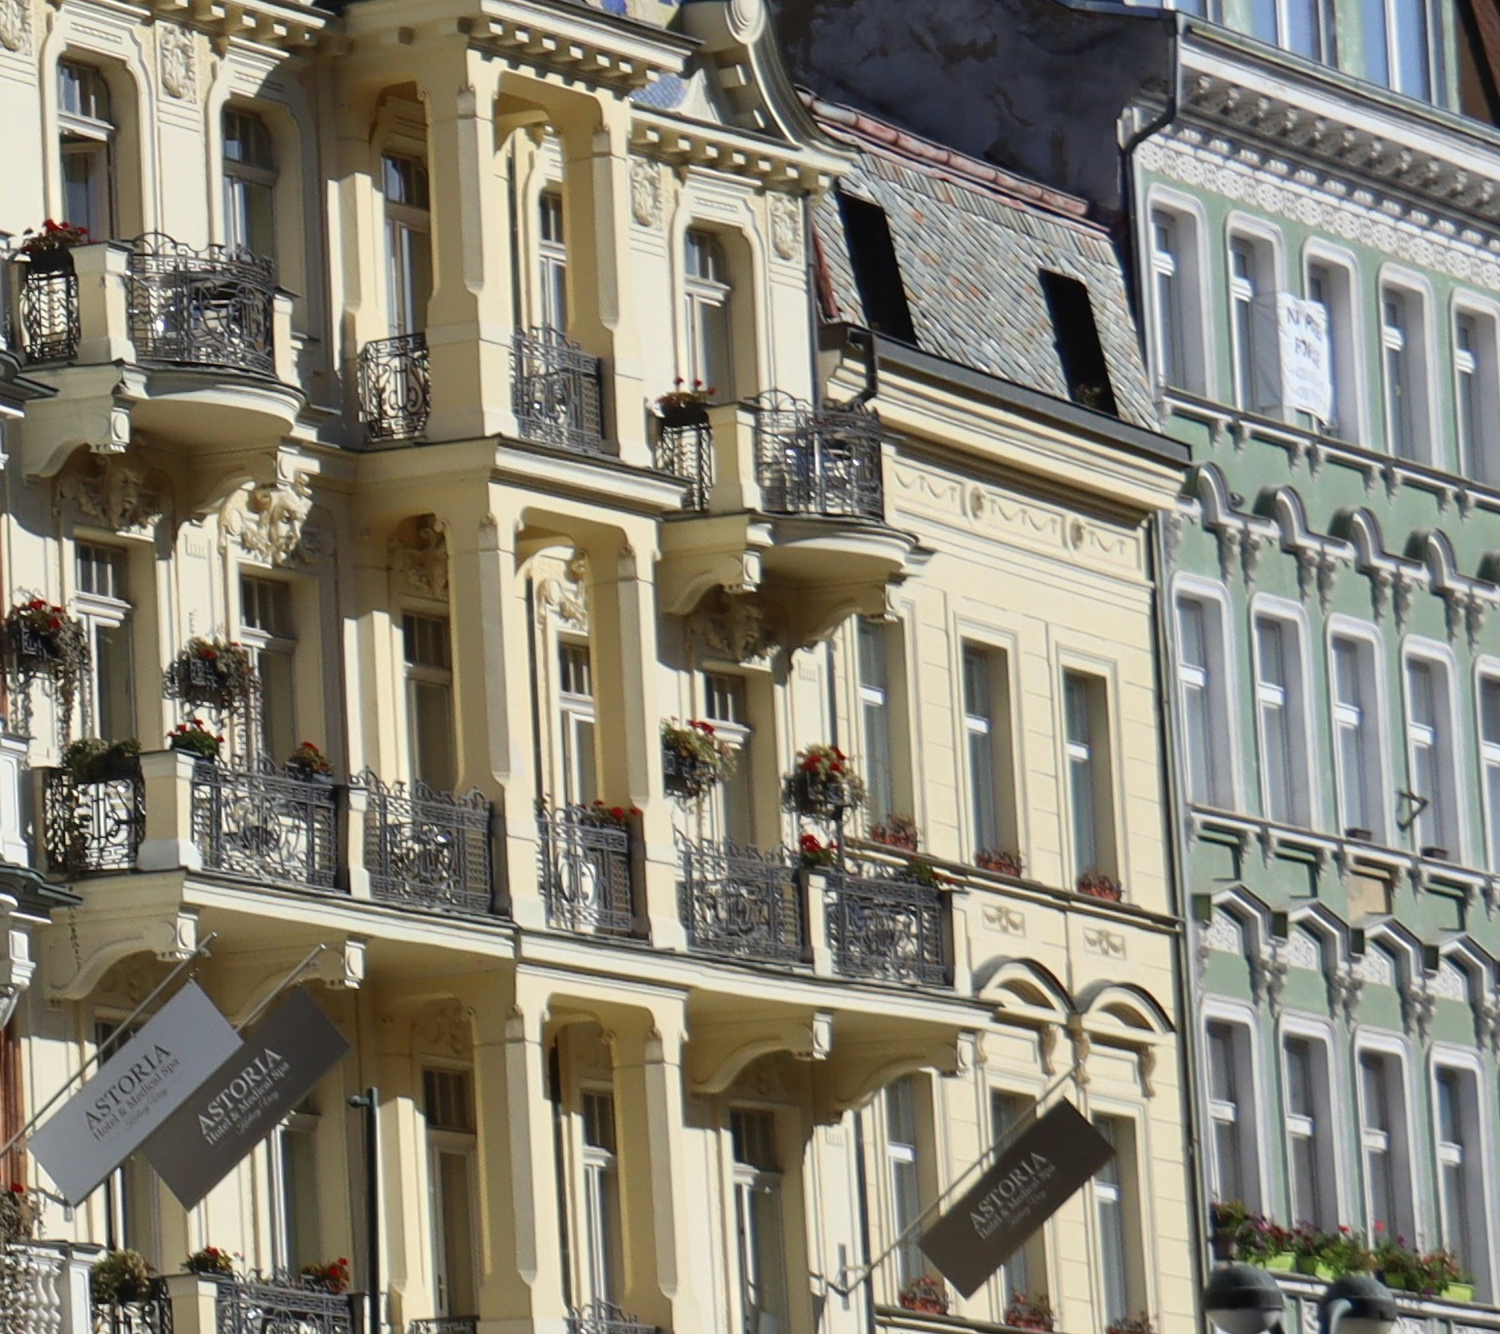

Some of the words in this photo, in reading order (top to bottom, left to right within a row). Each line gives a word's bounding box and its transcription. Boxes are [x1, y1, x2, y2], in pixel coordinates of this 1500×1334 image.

[85, 1044, 171, 1131] ASTORIA
[92, 1114, 119, 1141] Hotel
[119, 1107, 128, 1117] &
[126, 1072, 162, 1109] Medical
[160, 1057, 180, 1077] Spa
[198, 1047, 282, 1134] ASTORIA
[205, 1117, 232, 1145] Hotel
[237, 1076, 273, 1113] Medical
[271, 1061, 290, 1081] Spa
[969, 1151, 1046, 1230] ASTORIA
